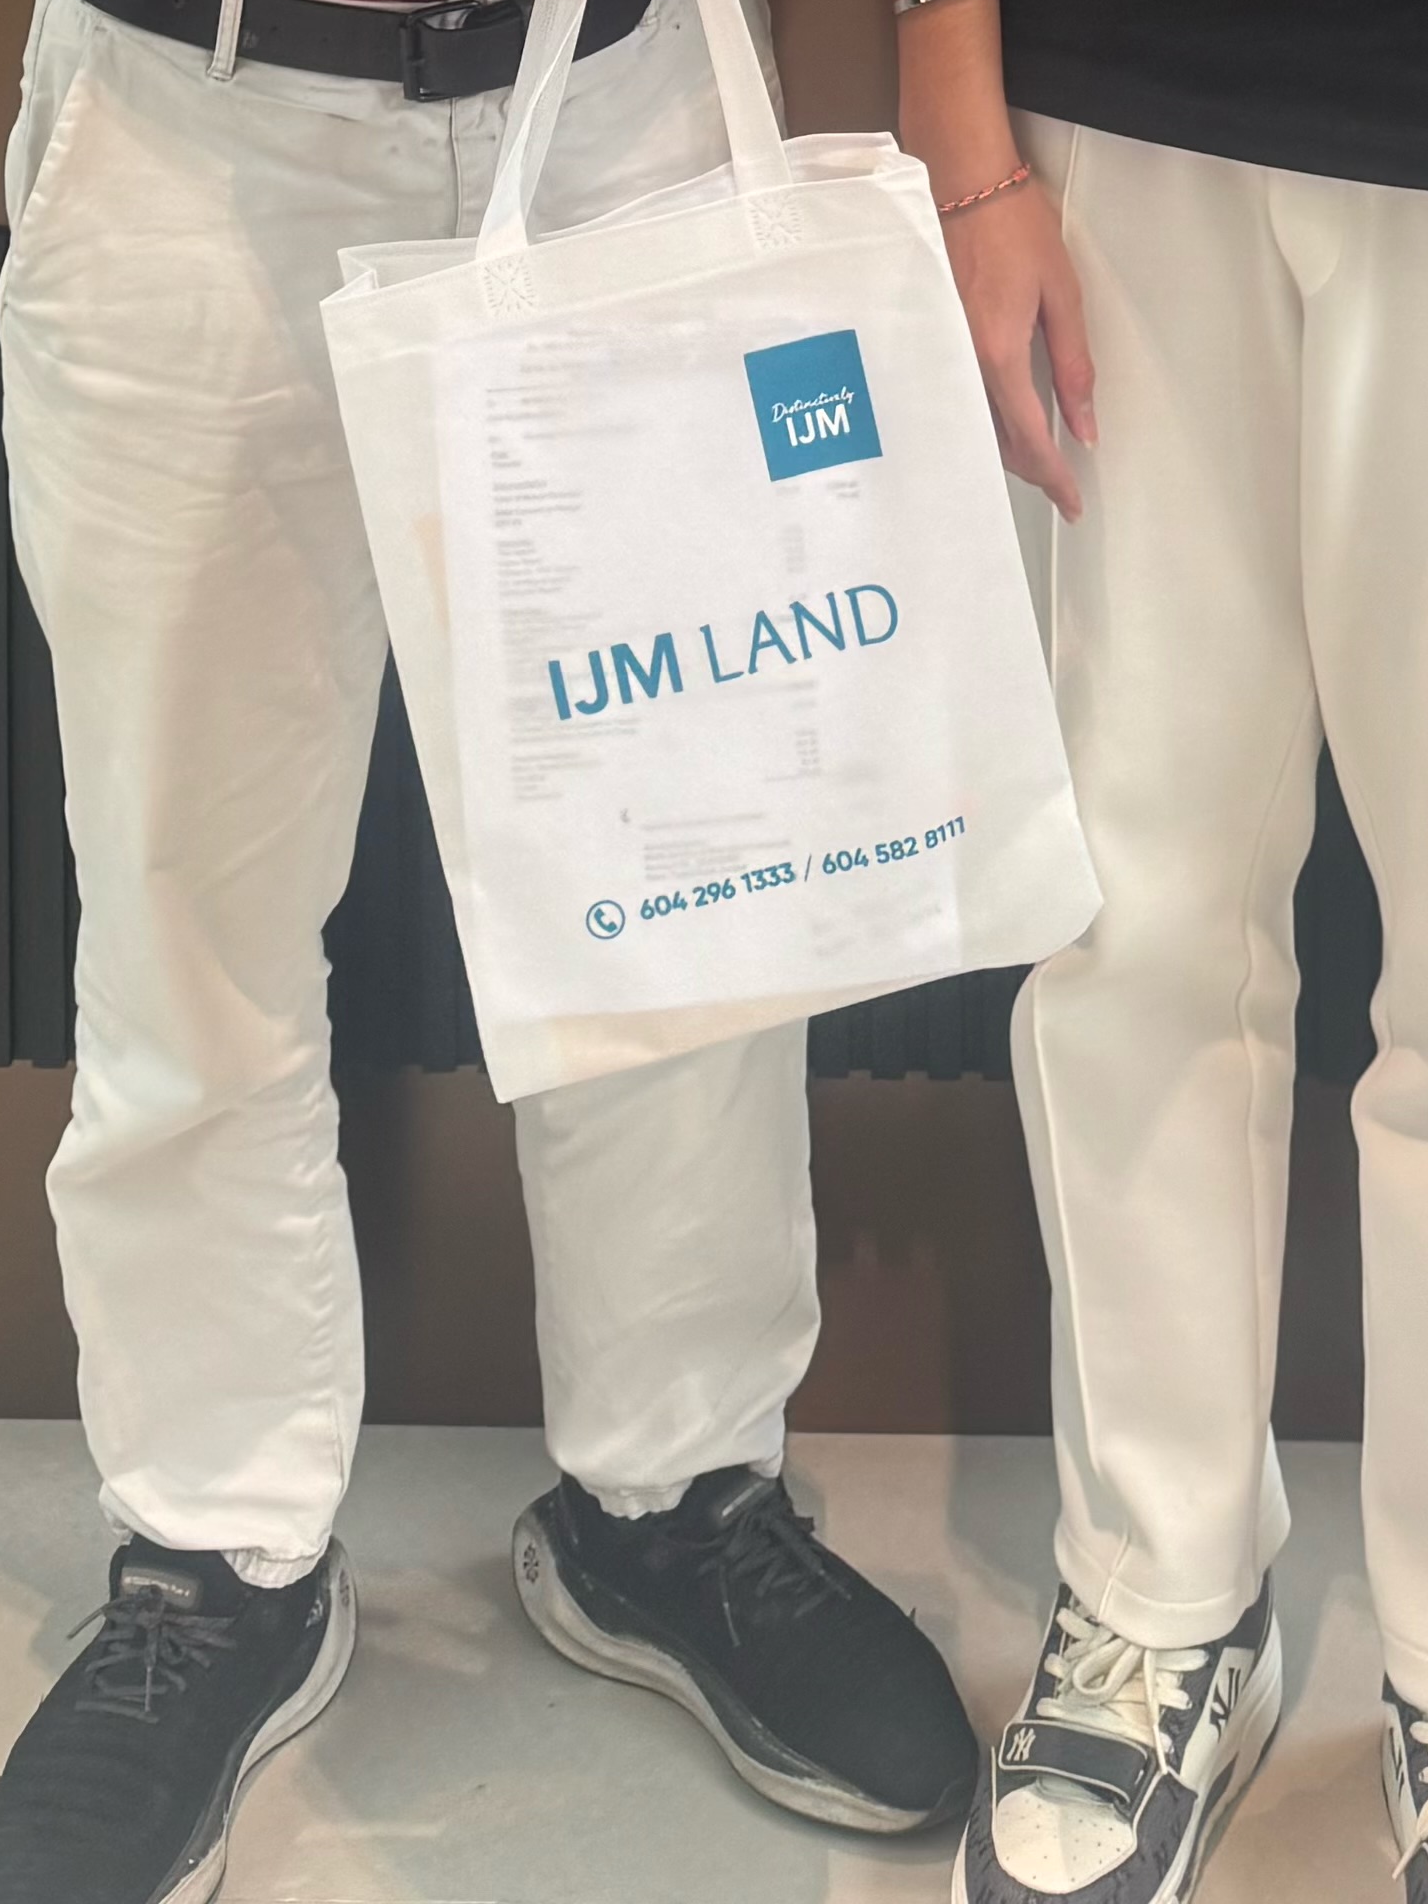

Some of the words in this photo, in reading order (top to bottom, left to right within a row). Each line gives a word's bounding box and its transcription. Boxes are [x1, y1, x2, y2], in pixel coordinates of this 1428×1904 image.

[786, 403, 851, 447] IJM
[548, 631, 683, 721] IJM
[699, 584, 899, 683] LAND
[640, 892, 688, 921] 604
[694, 879, 737, 908] 296
[741, 861, 797, 893] 1333
[822, 850, 870, 876] 604
[875, 836, 920, 865] 582
[924, 815, 967, 849] 8111
